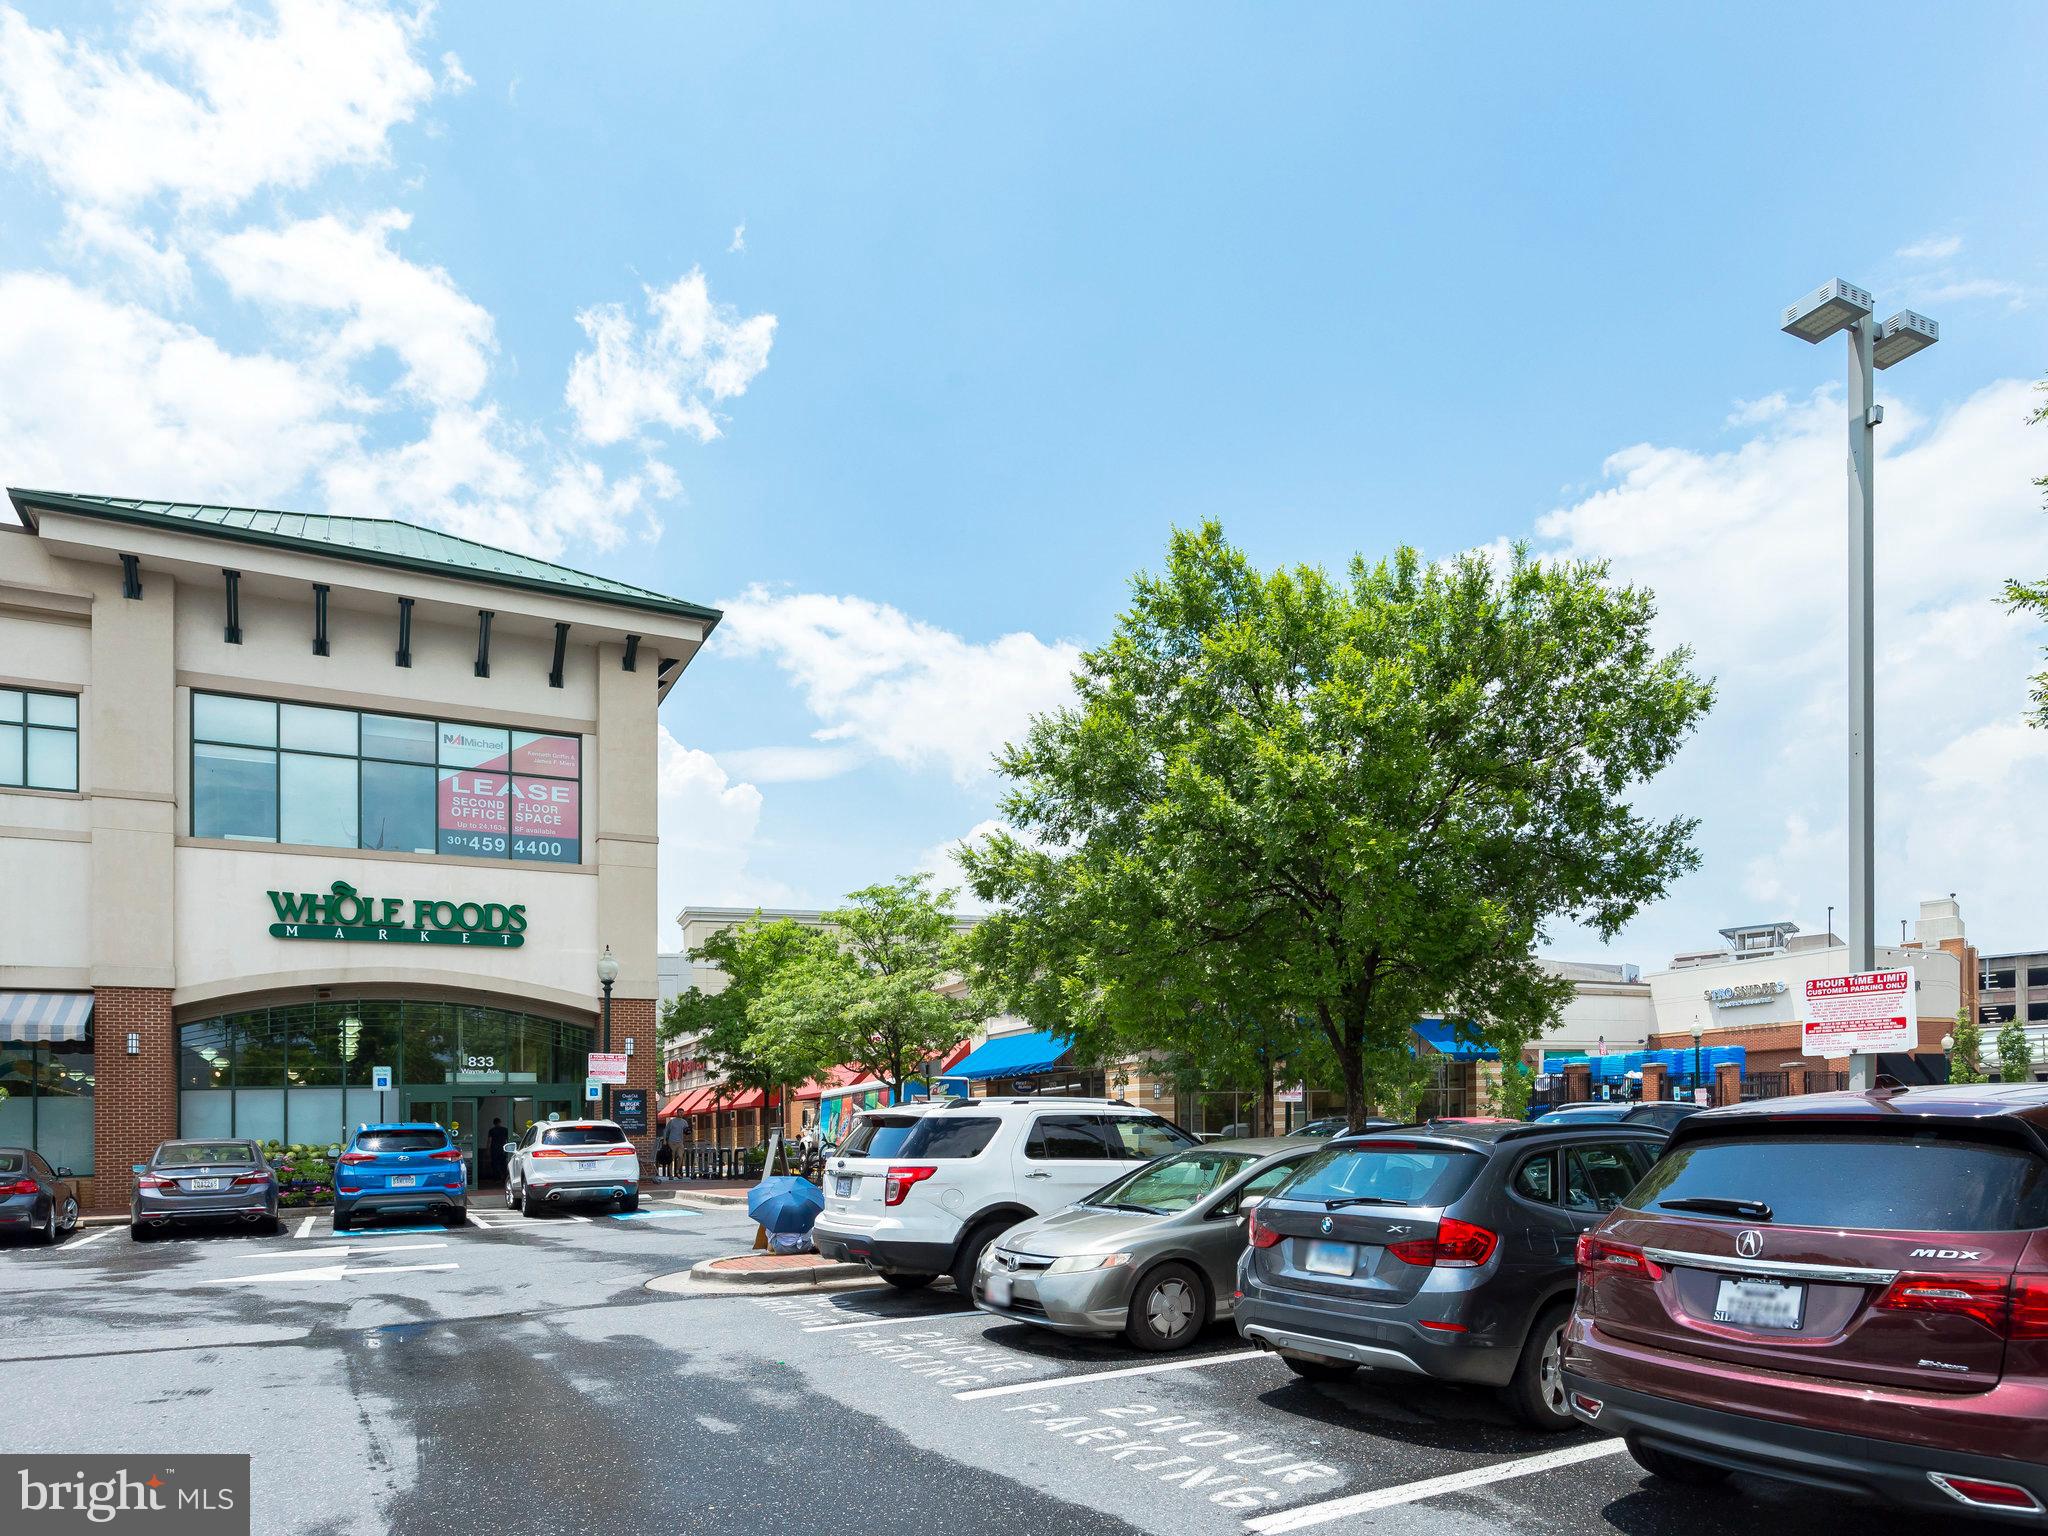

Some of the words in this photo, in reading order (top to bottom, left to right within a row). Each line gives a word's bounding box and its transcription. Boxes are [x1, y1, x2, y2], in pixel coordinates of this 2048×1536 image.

[464, 738, 503, 750] Michael
[452, 776, 570, 803] LEASE
[452, 796, 504, 810] SECOND
[518, 803, 558, 814] FLOOR
[451, 807, 505, 820] OFFICE
[515, 813, 561, 825] SPACE
[457, 821, 468, 829] Up
[526, 828, 556, 836] available
[447, 836, 467, 845] 301
[469, 837, 506, 852] 459
[514, 840, 561, 856] 4400
[267, 885, 405, 927] WHOLE
[413, 900, 527, 933] FOODS
[286, 924, 512, 945] MARKET
[1807, 986, 1849, 996] CUSTOMER
[1850, 984, 1883, 992] PARKING
[1886, 981, 1906, 989] ONLY
[1817, 978, 1846, 989] HOUR
[1848, 975, 1874, 985] TIME
[1877, 972, 1907, 983] LIMIT
[468, 1056, 494, 1067] 833
[1909, 1249, 1982, 1260] MDX
[839, 1331, 988, 1386] PARKING
[1001, 1402, 1280, 1508] PARKING
